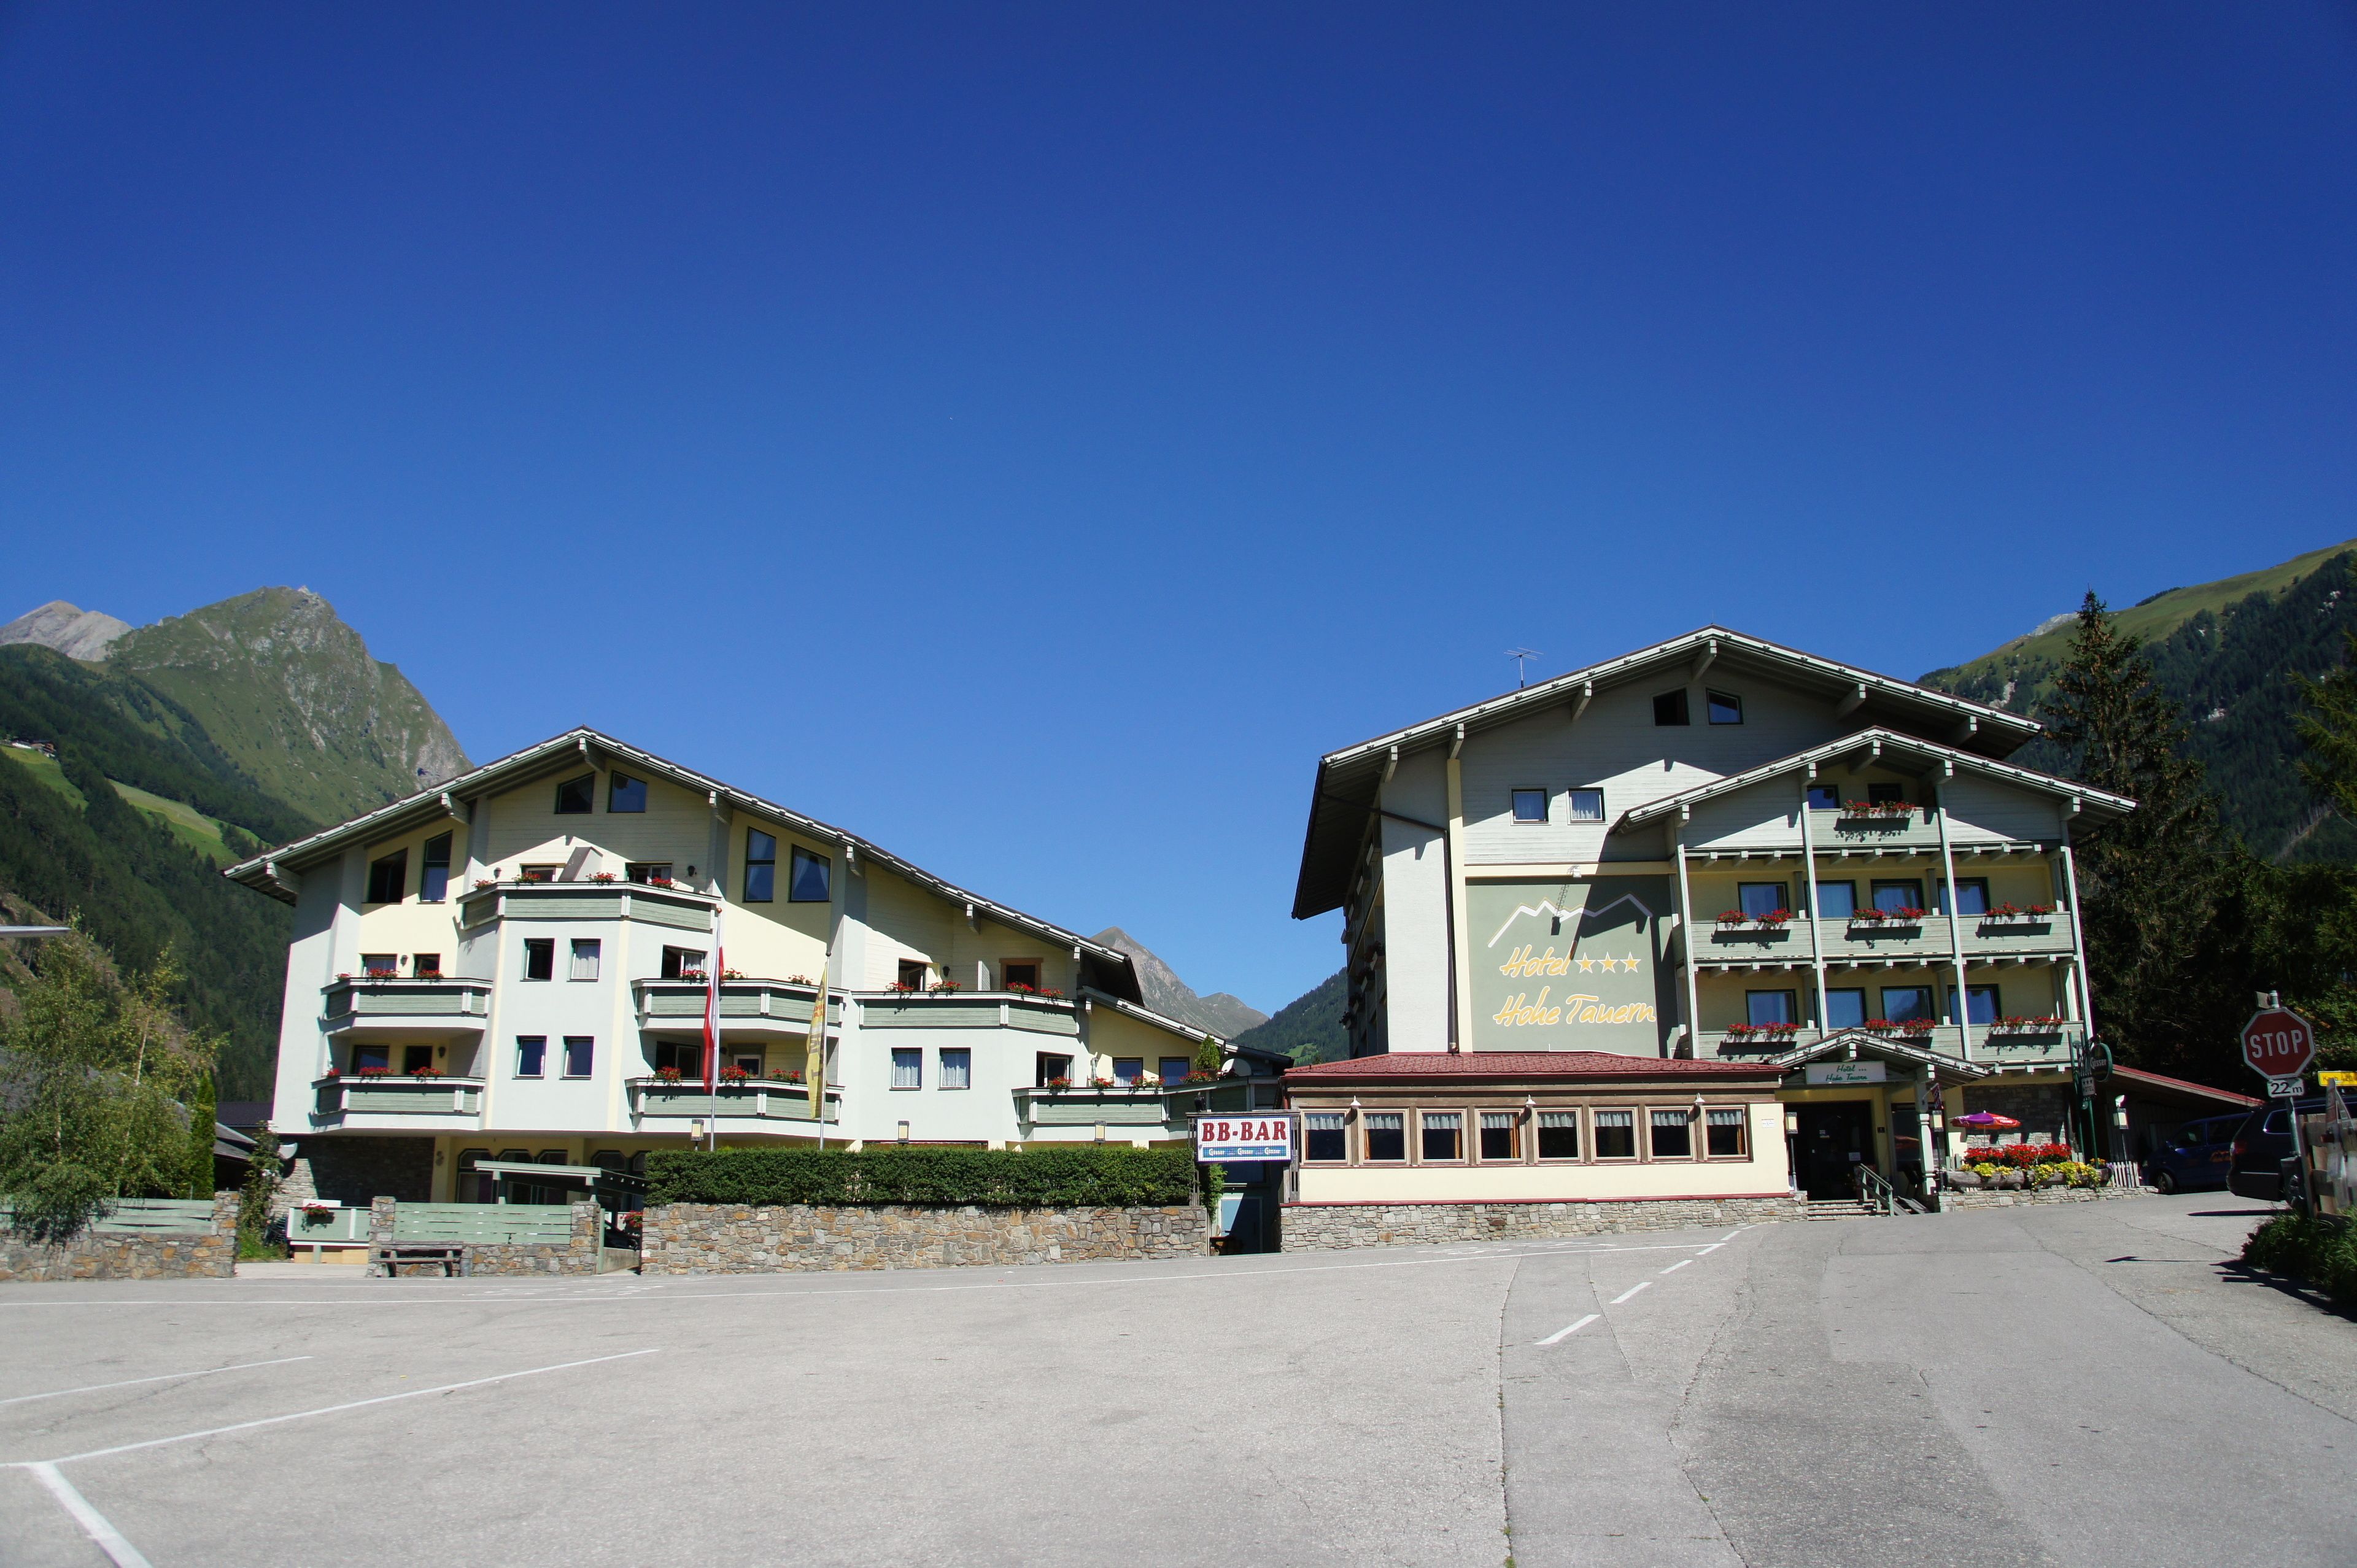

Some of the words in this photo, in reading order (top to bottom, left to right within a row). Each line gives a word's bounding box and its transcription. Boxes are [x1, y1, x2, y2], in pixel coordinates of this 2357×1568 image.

[1500, 941, 1578, 978] Hotel
[1493, 986, 1562, 1026] Hohe
[1566, 994, 1657, 1024] Tauern
[2250, 1029, 2302, 1059] STOP
[2270, 1082, 2290, 1095] 22
[1202, 1121, 1287, 1141] BB-BAR
